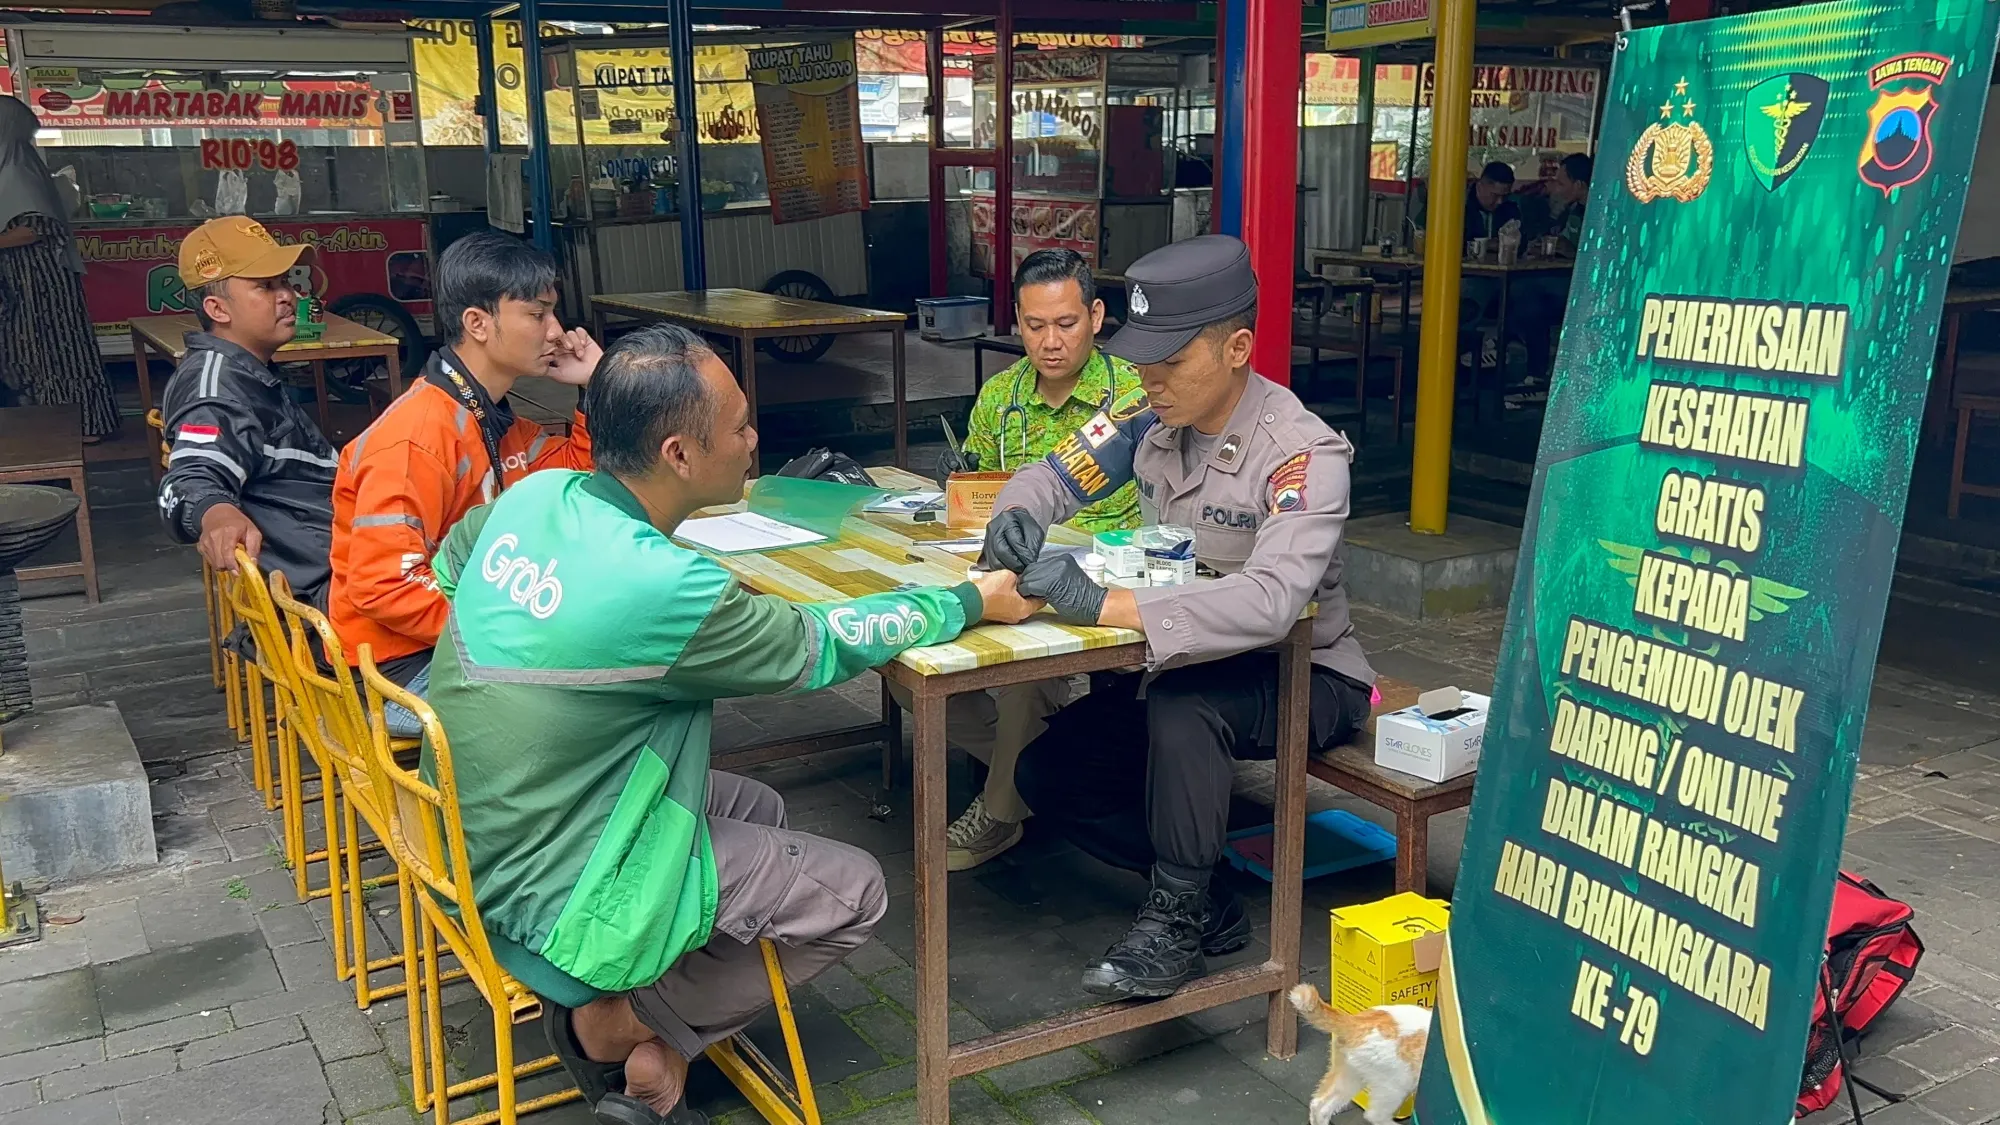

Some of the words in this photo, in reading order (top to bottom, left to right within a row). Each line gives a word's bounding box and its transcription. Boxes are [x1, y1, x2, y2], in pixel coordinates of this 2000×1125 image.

[751, 50, 794, 70] KUPAT
[798, 43, 832, 65] TAHU
[1874, 59, 1904, 82] JAWA
[1902, 56, 1944, 77] TENGAH
[36, 69, 70, 77] HALAL
[594, 67, 645, 85] KUPAT
[652, 67, 672, 85] TA
[779, 66, 813, 84] MAJU
[815, 60, 853, 80] DJOYO
[106, 91, 263, 118] MARTABAK
[279, 92, 369, 118] MANIS
[1498, 126, 1558, 148] SABAR
[203, 138, 299, 171] RIO'98
[599, 156, 659, 180] LONTONG
[323, 226, 386, 251] Asin
[1636, 297, 1848, 378] PEMERIKSAAN
[1640, 383, 1808, 469] KESEHATAN
[1201, 505, 1257, 530] POLRI
[1656, 473, 1765, 553] GRATIS
[482, 533, 563, 620] Grab
[1633, 554, 1750, 642] KEPADA
[828, 604, 928, 646] Grab
[1562, 619, 1728, 727] PENGEMUDI
[1723, 671, 1804, 754] OJEK
[1549, 699, 1662, 786] DARING
[1656, 737, 1682, 796] /
[1677, 745, 1789, 844] ONLINE
[1540, 777, 1642, 865] DALAM
[1638, 818, 1761, 929] RANGKA
[1494, 840, 1568, 921] HARI
[1562, 870, 1772, 1032] BHAYANGKARA
[1390, 980, 1433, 1003] SAFETY
